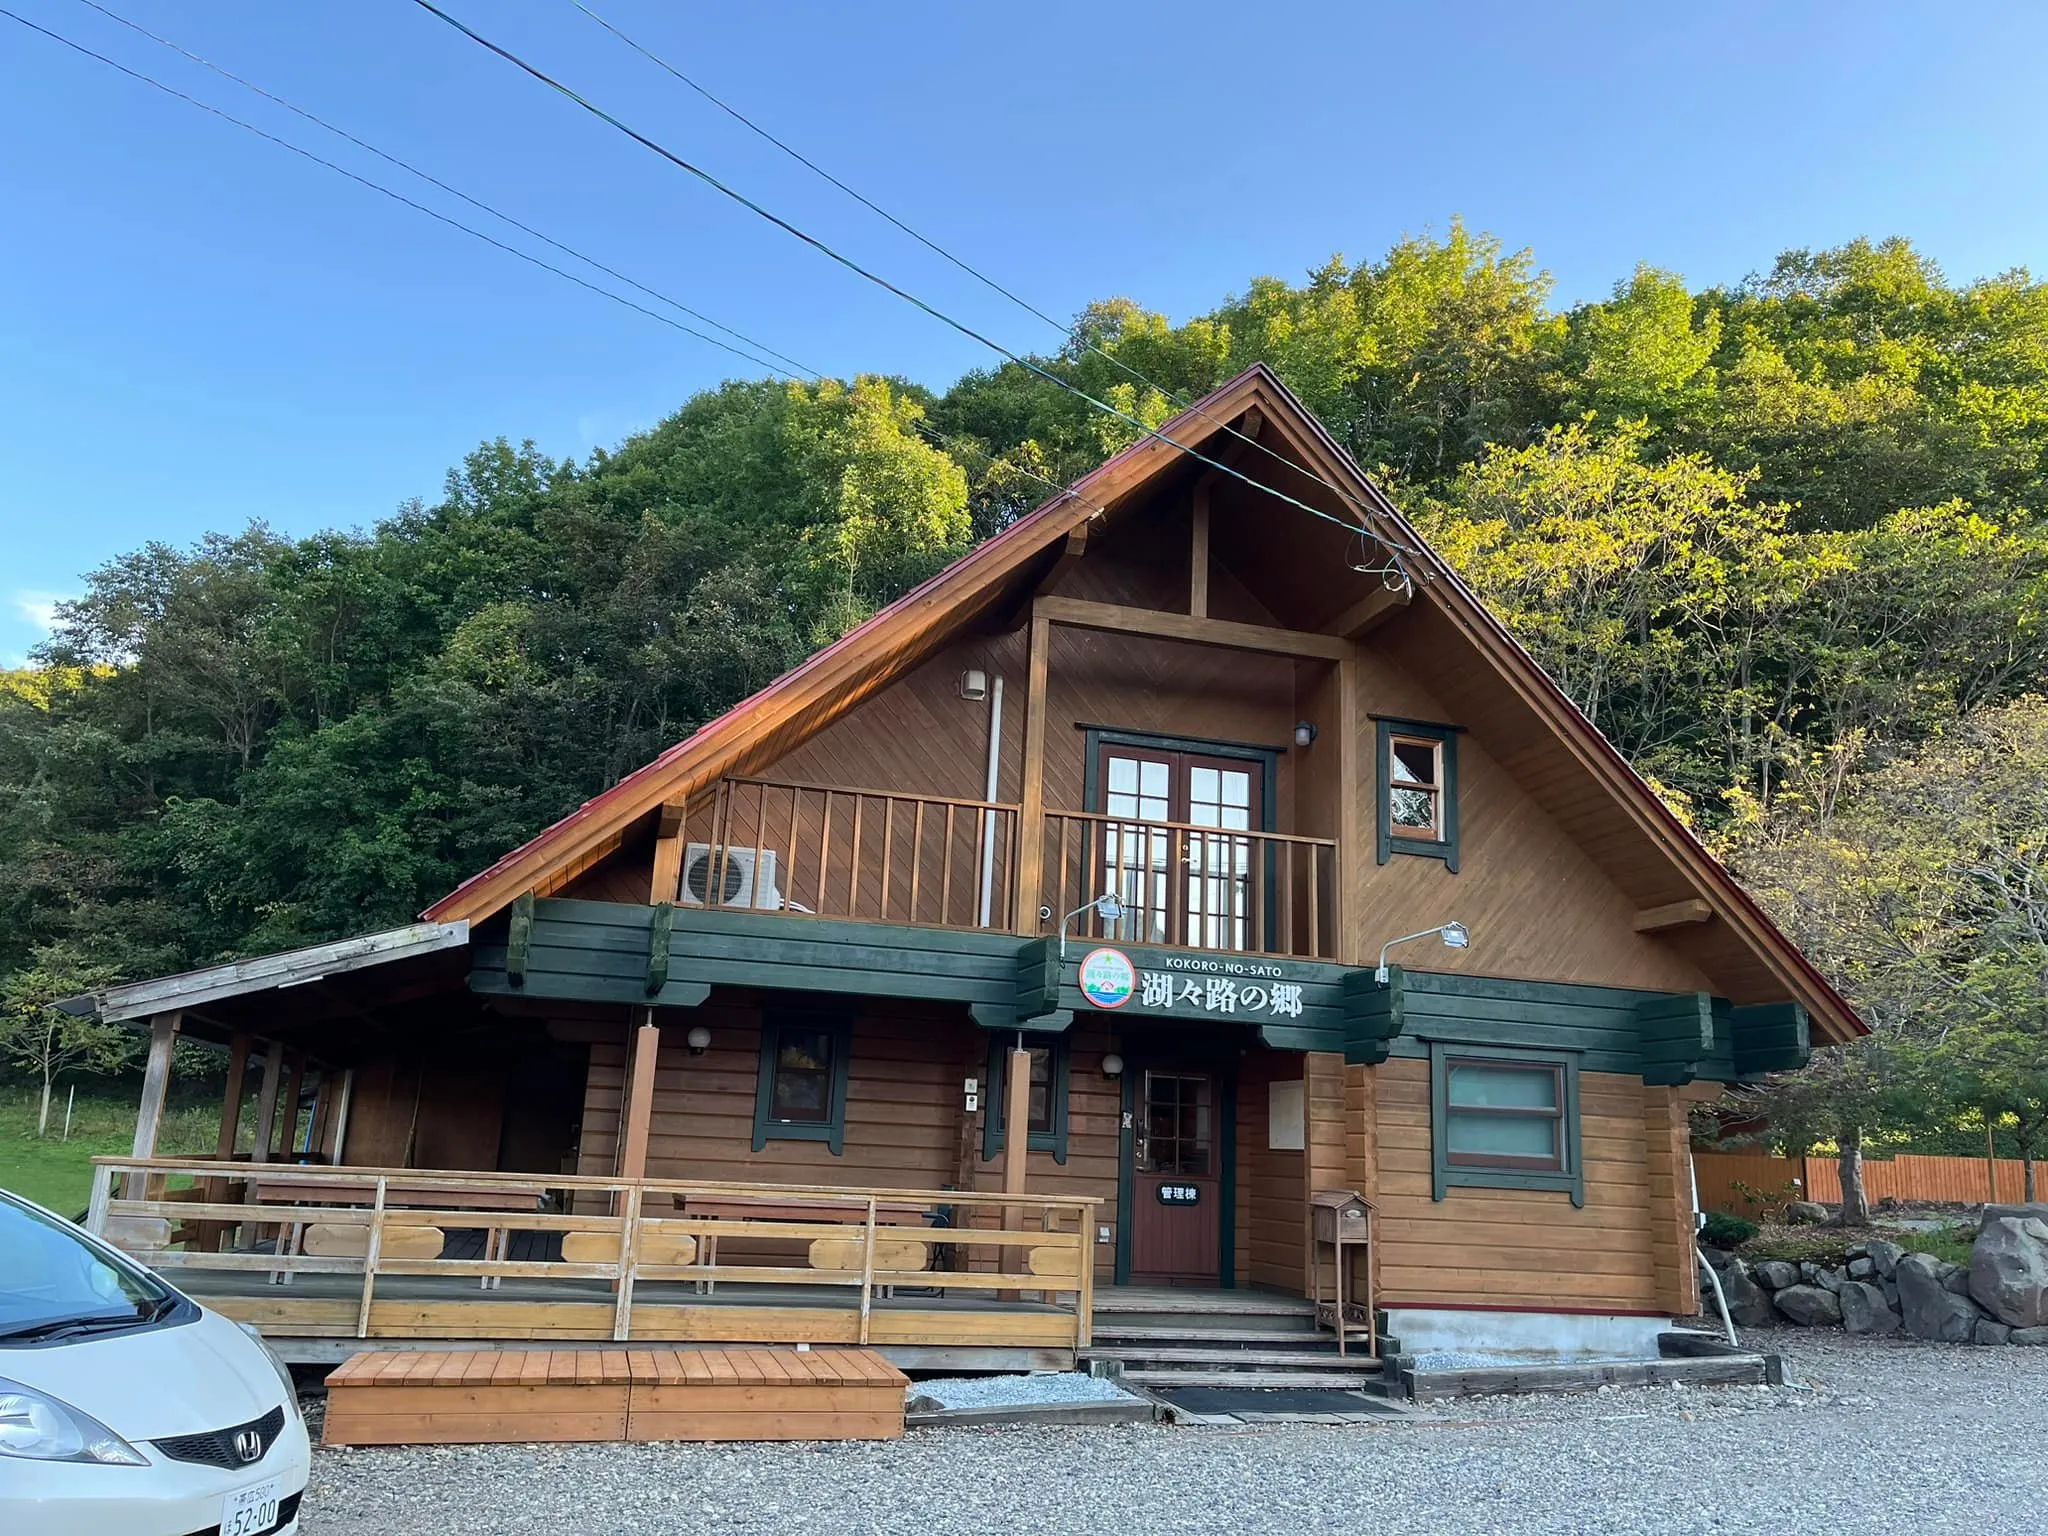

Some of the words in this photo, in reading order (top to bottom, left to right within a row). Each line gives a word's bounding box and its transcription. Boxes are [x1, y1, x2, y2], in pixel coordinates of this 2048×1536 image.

[1165, 957, 1283, 978] KOKORO-NO-SATO
[1141, 972, 1303, 1018] 湖々路の郷
[1161, 1186, 1197, 1200] 管理棟
